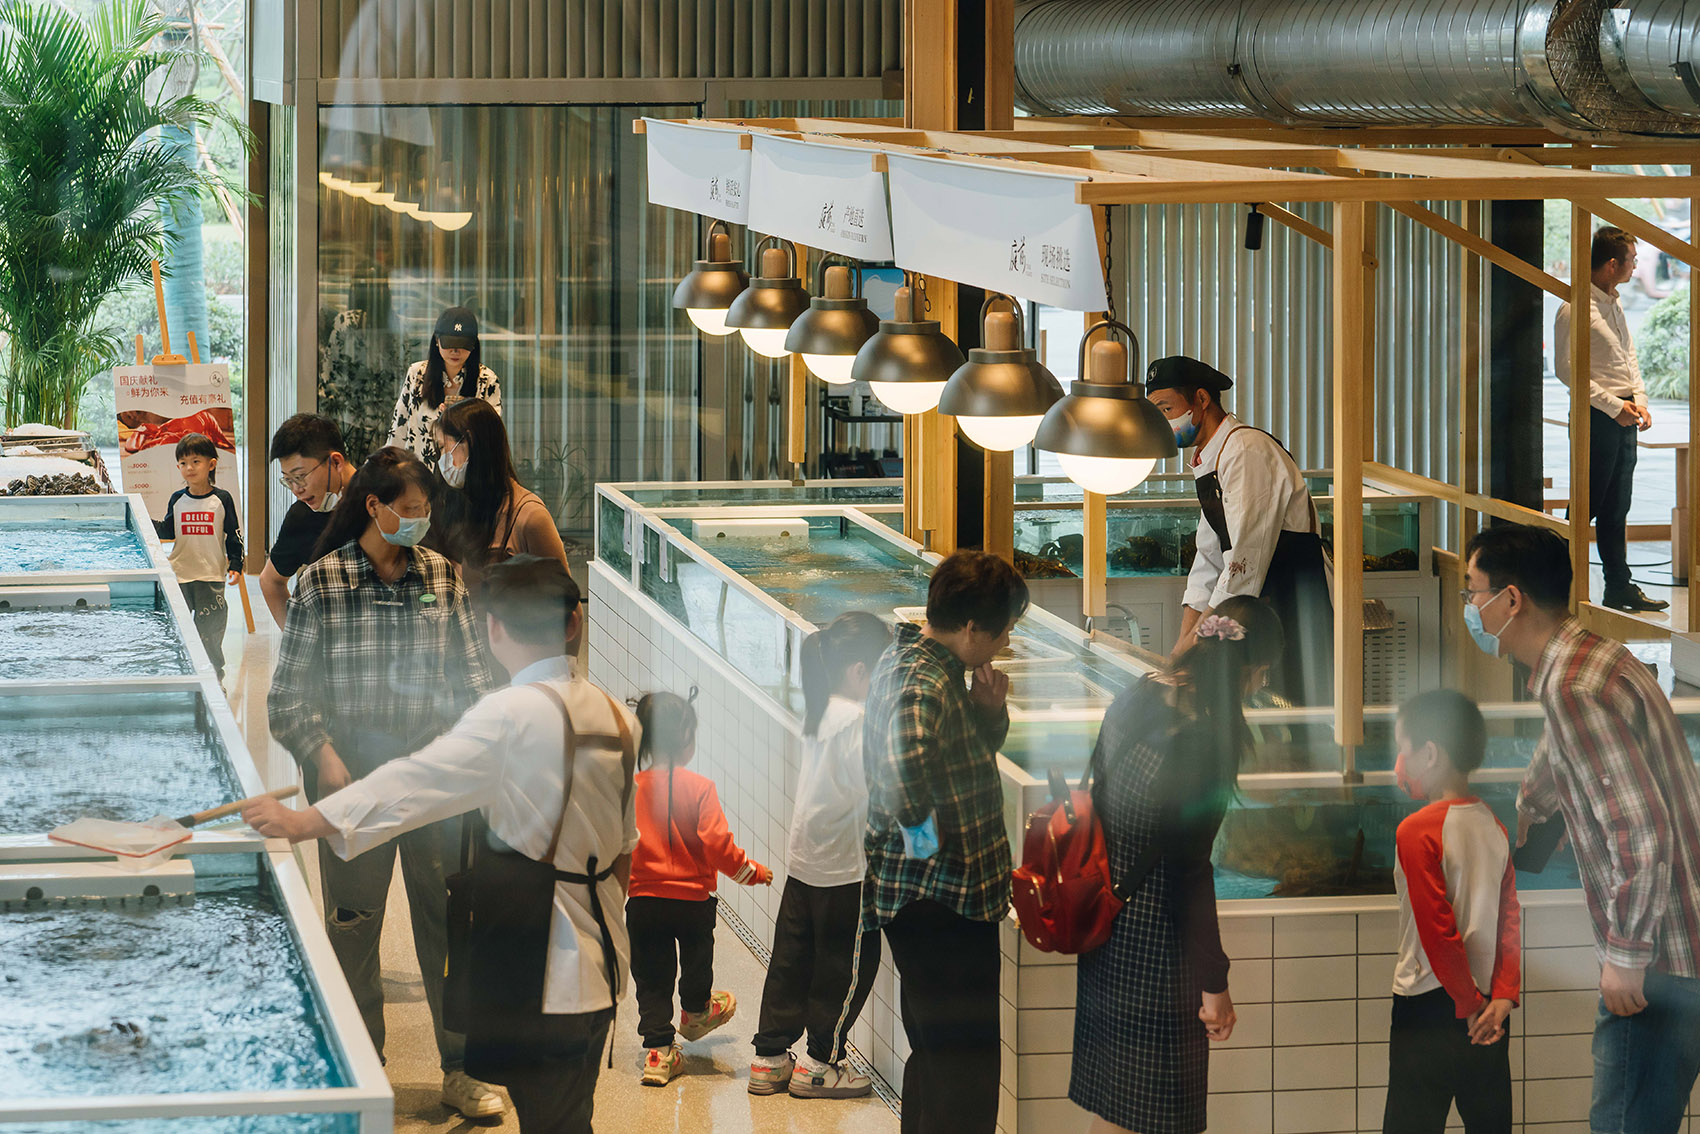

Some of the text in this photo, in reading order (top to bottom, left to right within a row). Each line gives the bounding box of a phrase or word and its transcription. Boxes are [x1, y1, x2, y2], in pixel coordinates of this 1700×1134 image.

[1041, 244, 1071, 272] 现场挑选
[119, 375, 158, 386] 国庆献礼
[180, 394, 226, 405] 充值有豪礼
[185, 513, 209, 521] DELIG
